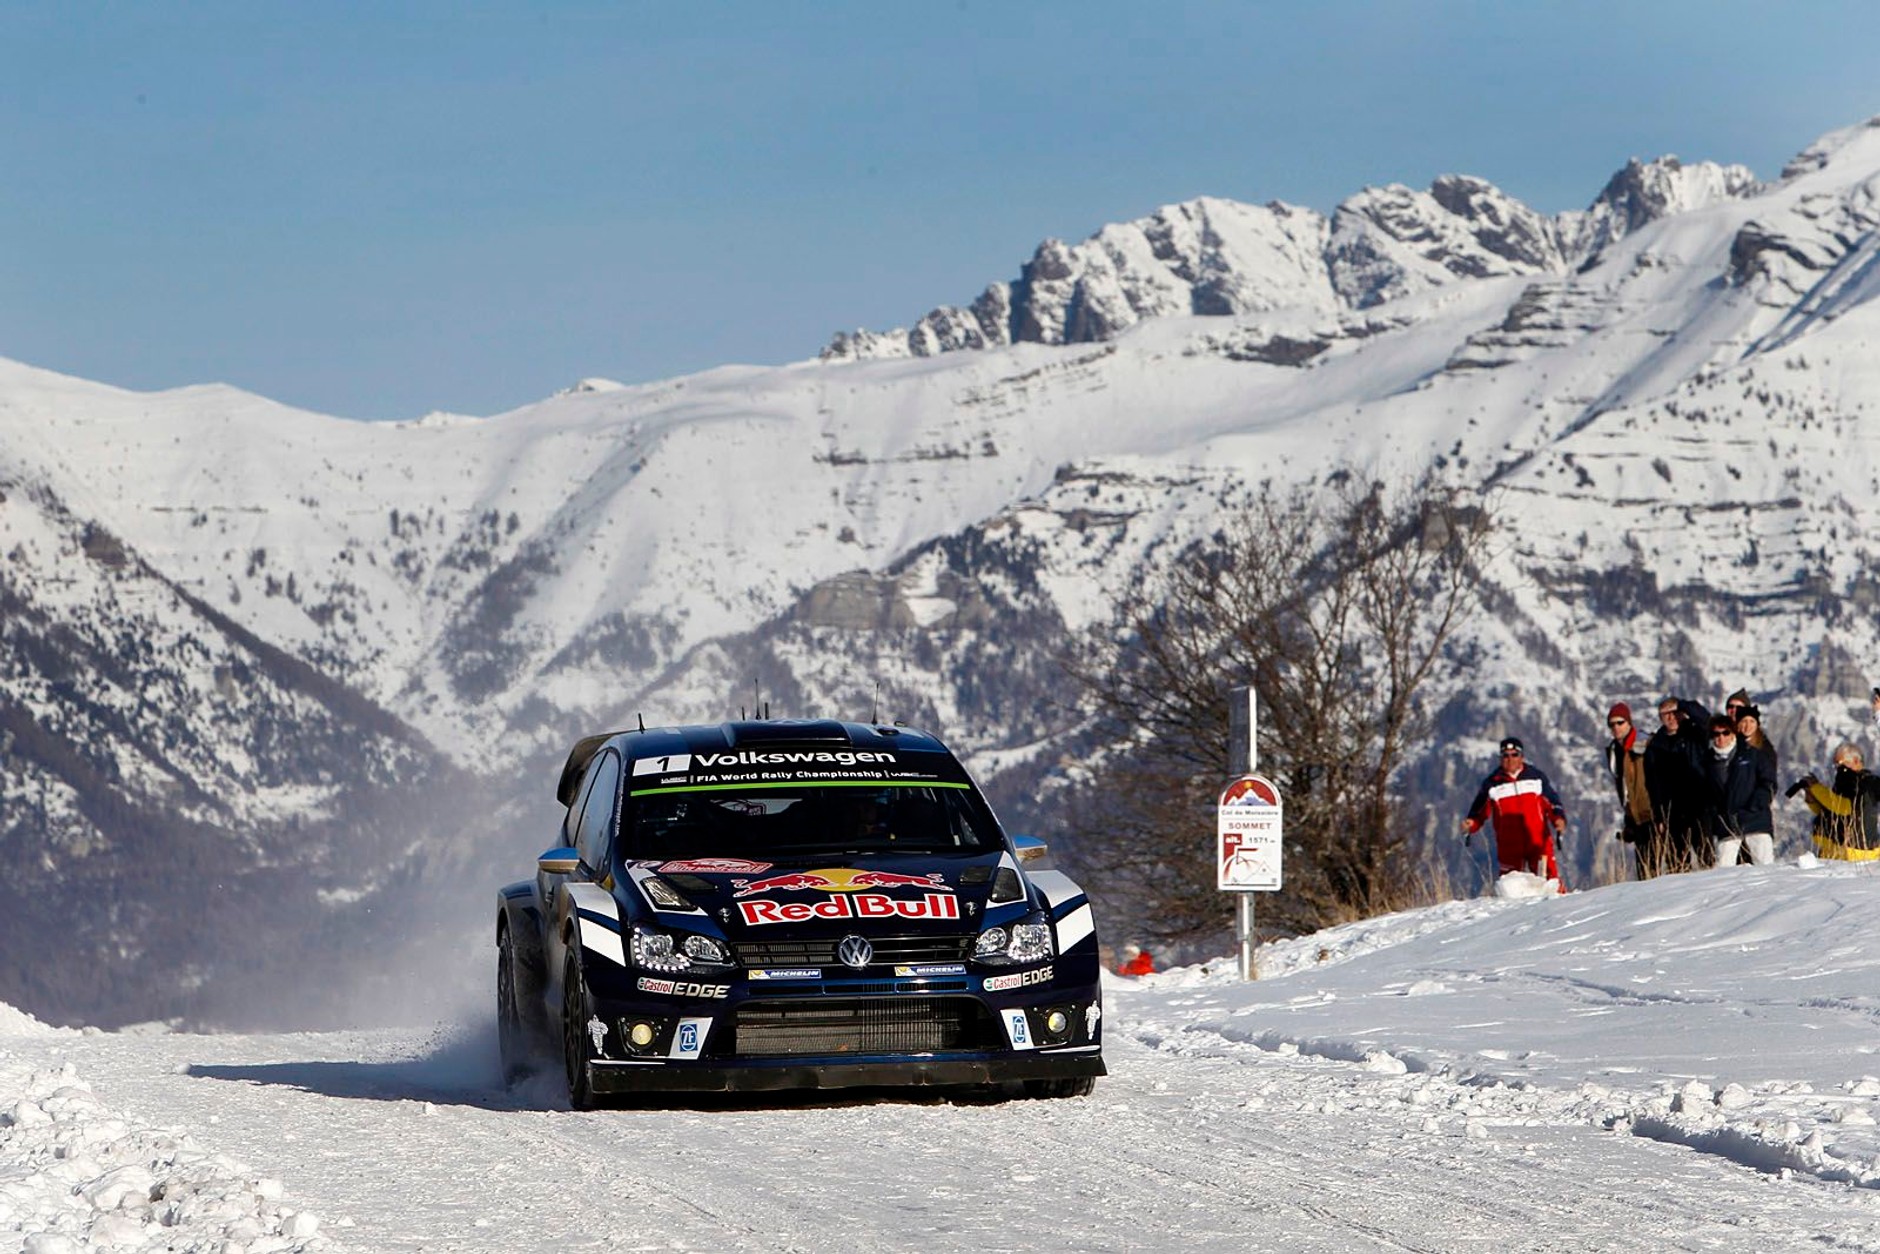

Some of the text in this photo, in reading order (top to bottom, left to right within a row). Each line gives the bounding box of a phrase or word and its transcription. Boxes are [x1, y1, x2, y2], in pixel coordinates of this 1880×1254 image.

[656, 756, 670, 772] 1
[694, 751, 897, 767] Volkswagen
[720, 772, 758, 781] World
[761, 771, 793, 780] Rally
[796, 770, 883, 779] Championship
[1228, 822, 1272, 830] SOMMET
[1249, 836, 1268, 844] 1571
[737, 894, 960, 926] Red Bull
[993, 965, 1054, 990] Castrol EDGE
[644, 979, 731, 999] Castrol EDGE
